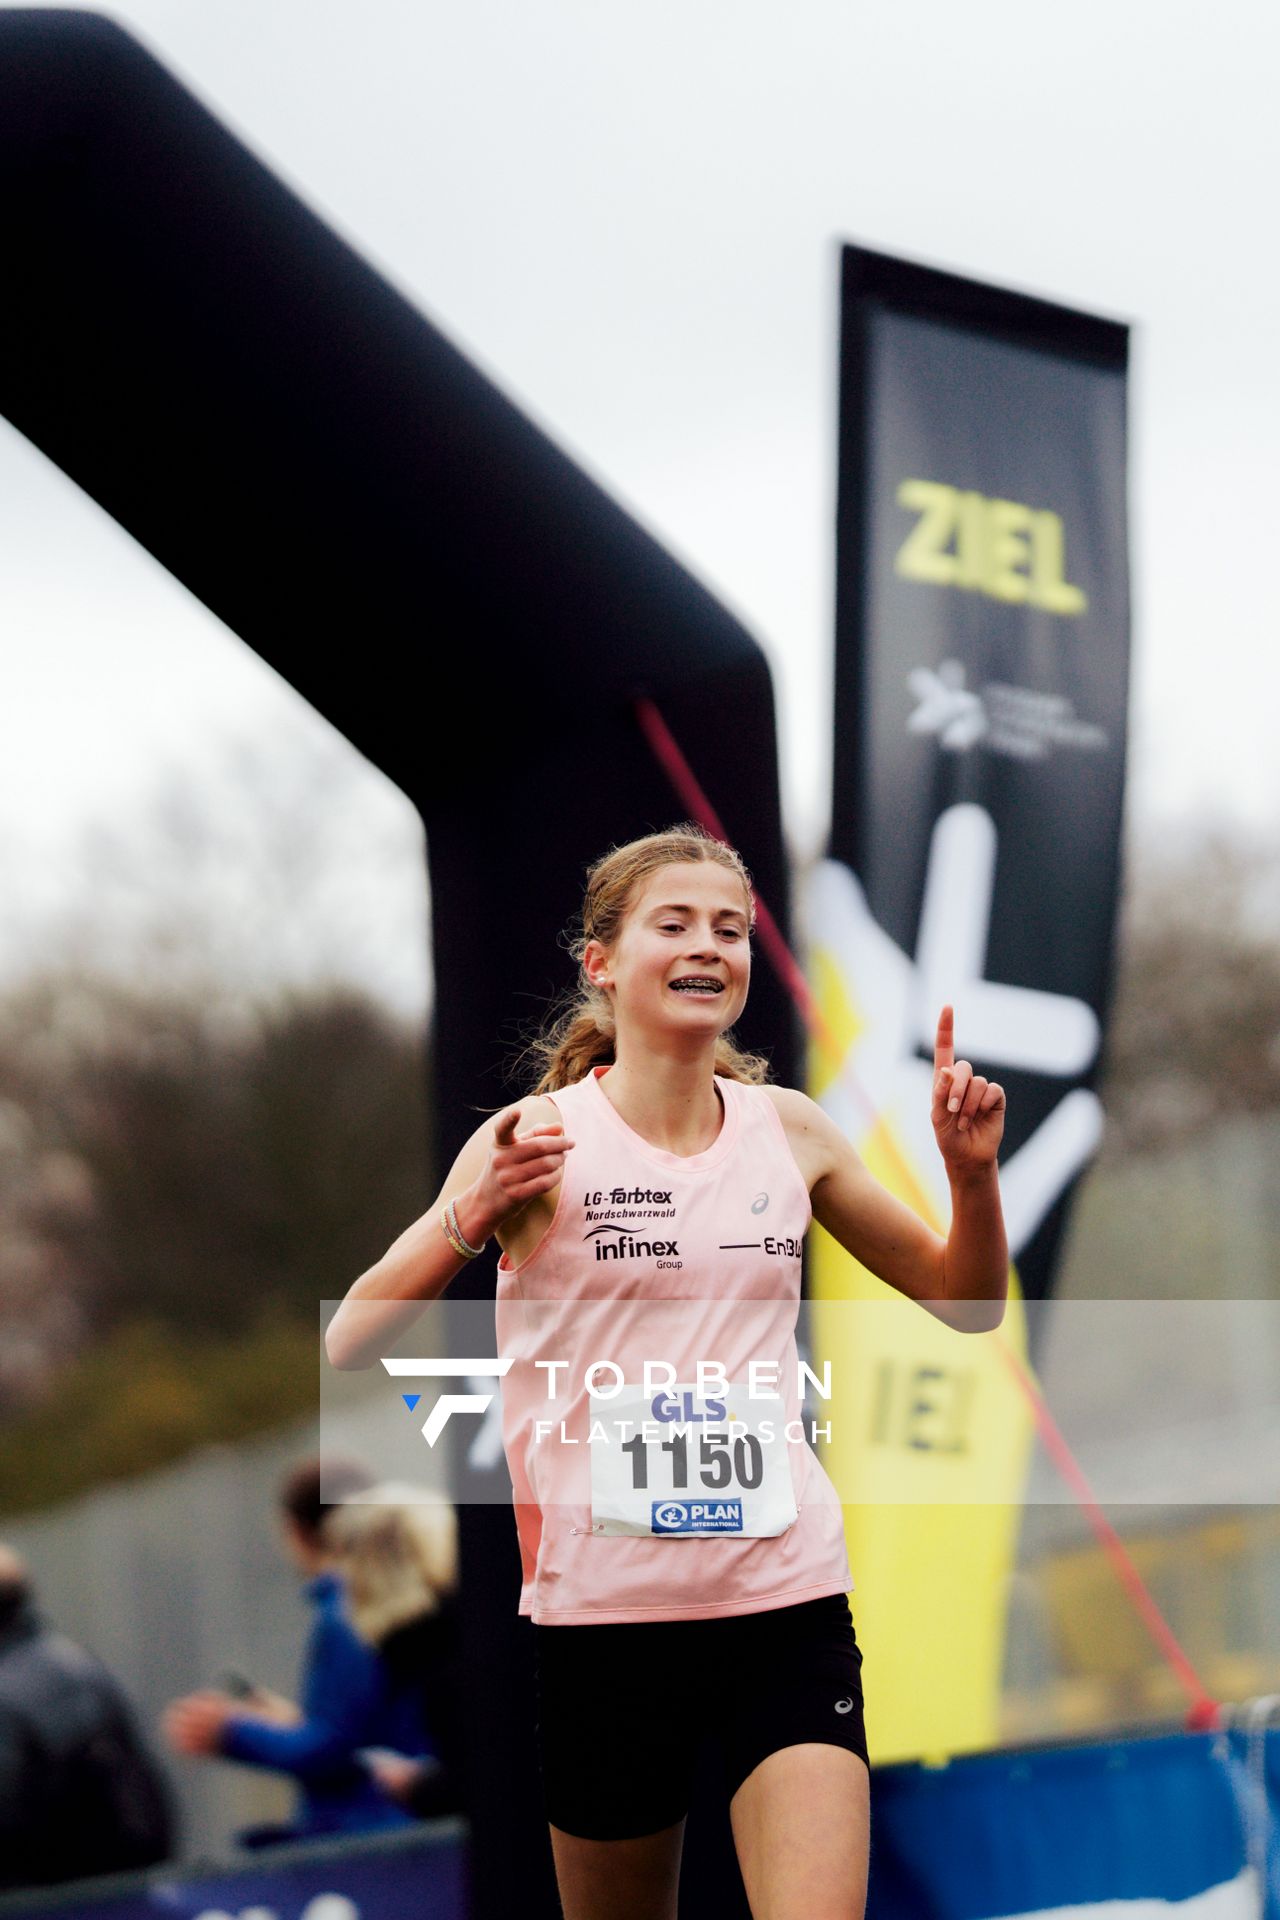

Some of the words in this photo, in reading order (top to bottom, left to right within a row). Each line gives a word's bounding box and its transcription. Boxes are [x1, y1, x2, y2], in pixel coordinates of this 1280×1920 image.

[897, 478, 1088, 616] ZIEL
[586, 1208, 676, 1221] Nordschwarzwald
[595, 1236, 680, 1261] infinex
[656, 1260, 683, 1270] Group
[622, 1433, 764, 1490] 1150
[691, 1505, 740, 1520] PLAN
